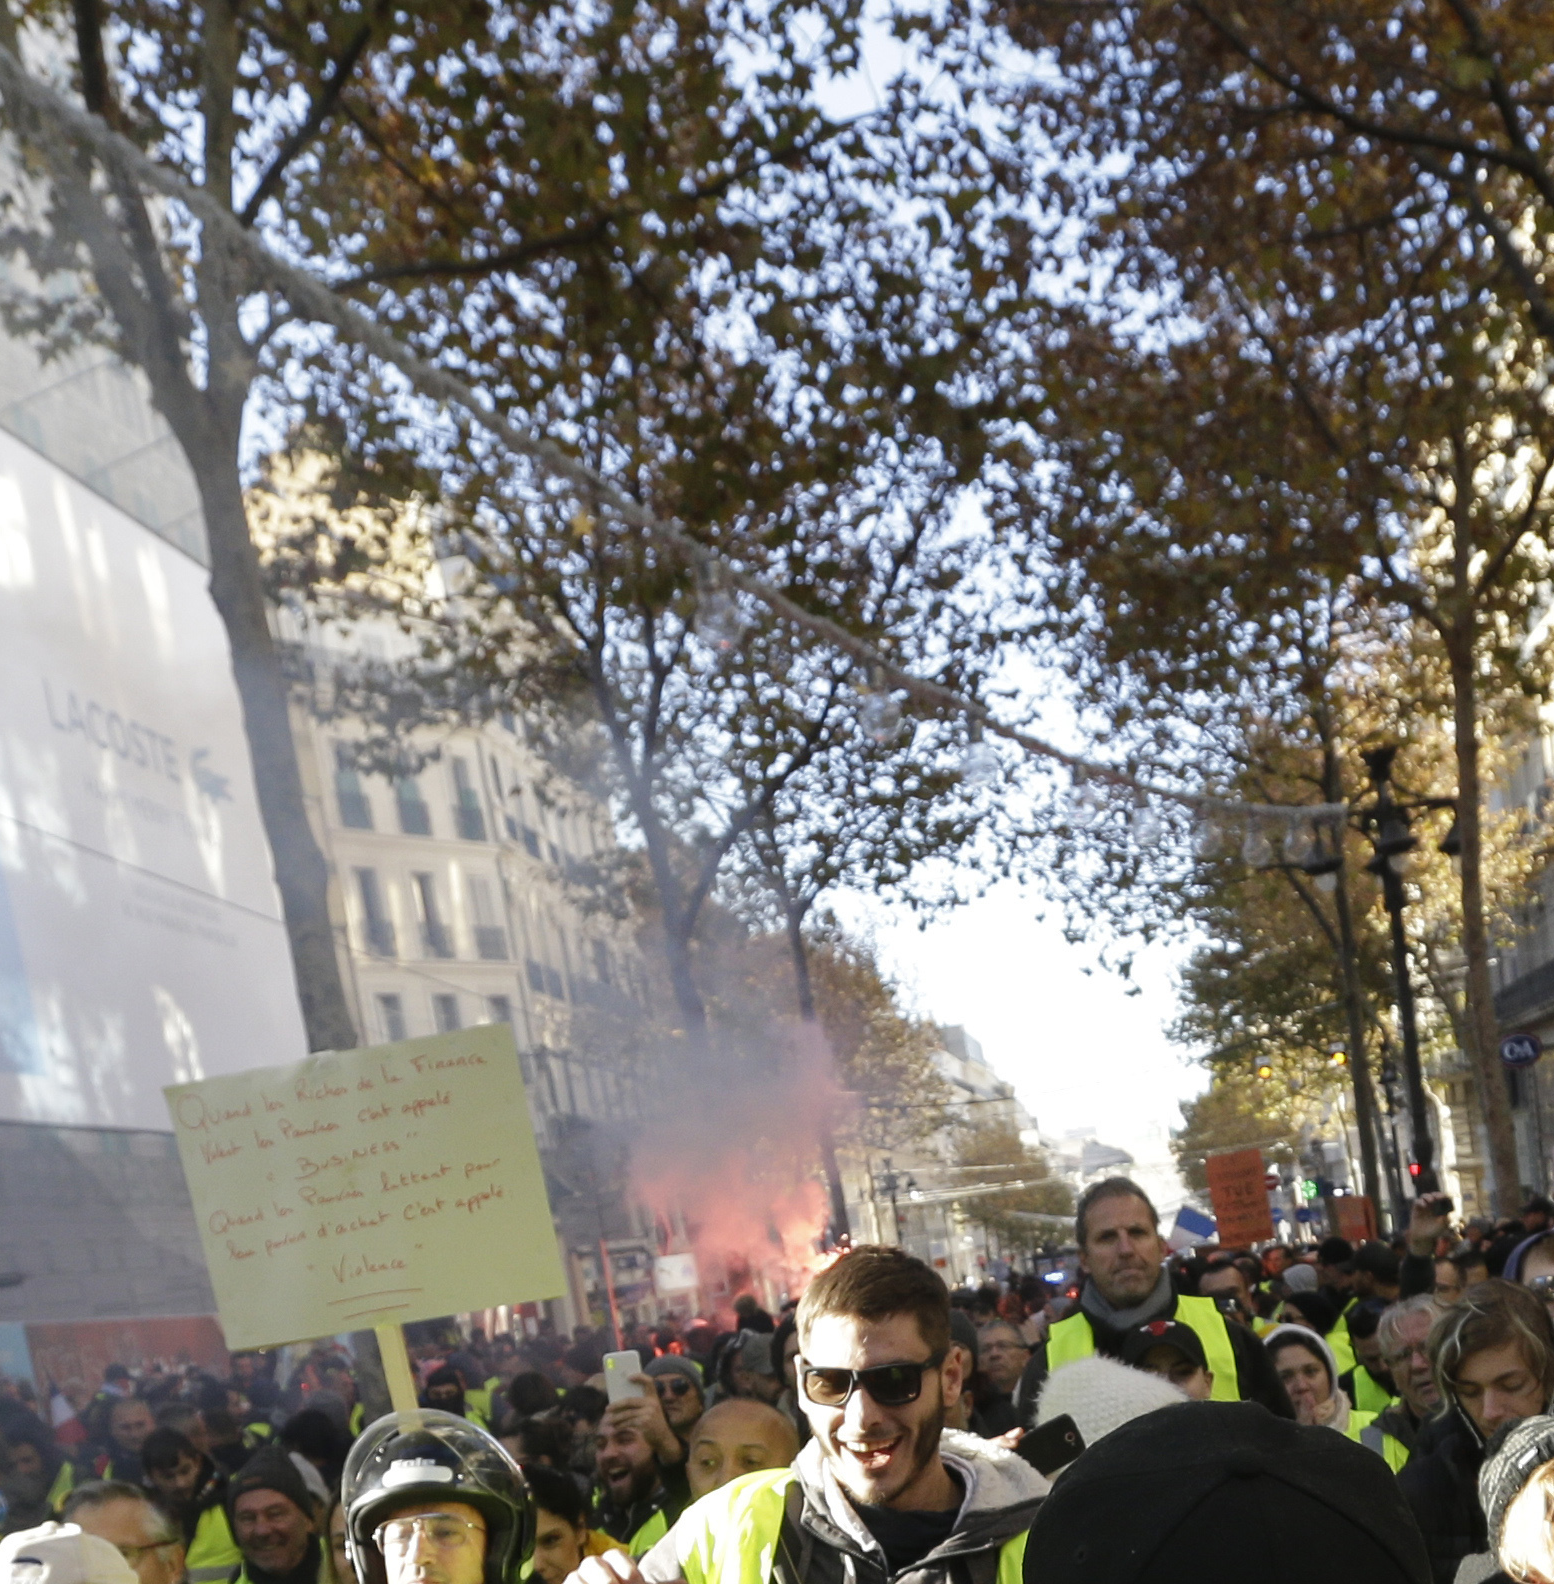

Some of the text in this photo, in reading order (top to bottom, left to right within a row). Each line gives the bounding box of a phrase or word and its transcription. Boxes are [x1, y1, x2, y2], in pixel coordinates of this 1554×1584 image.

[41, 676, 183, 784] LACOSTE
[177, 1093, 252, 1133] Quand
[295, 1077, 349, 1099] Riches
[357, 1076, 375, 1091] de
[208, 1207, 266, 1236] Quand
[331, 1253, 408, 1284] Violence
